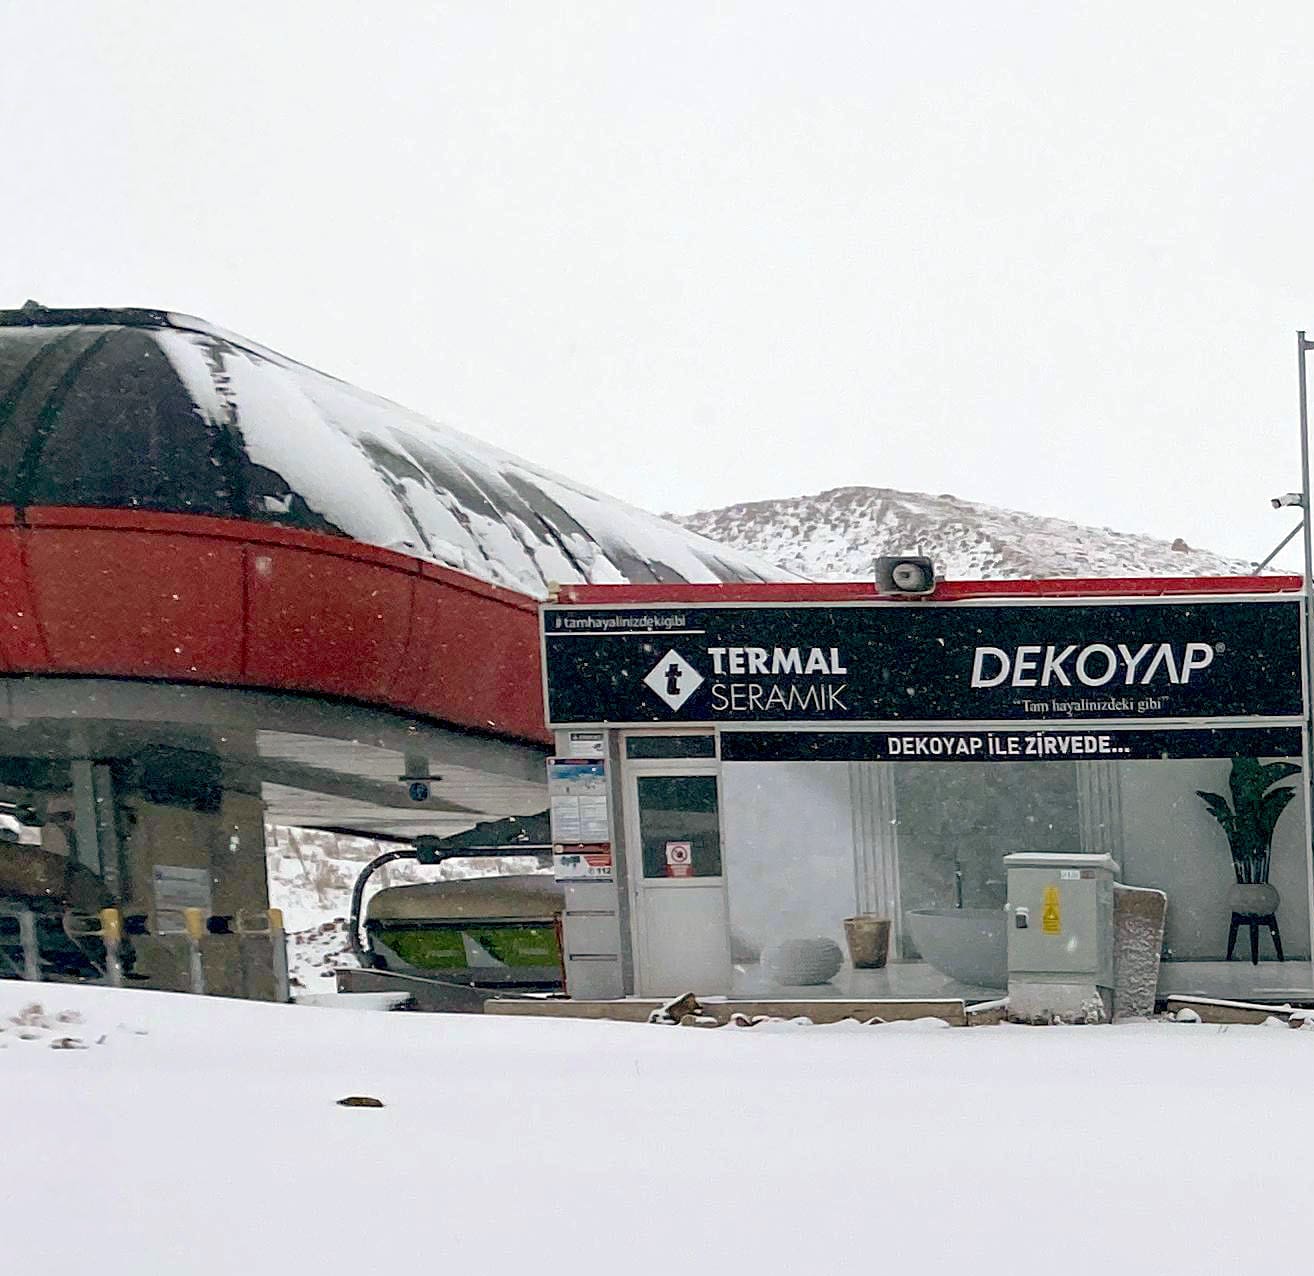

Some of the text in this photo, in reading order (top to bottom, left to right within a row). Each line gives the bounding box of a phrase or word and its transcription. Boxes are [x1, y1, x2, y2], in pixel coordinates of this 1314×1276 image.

[708, 647, 848, 675] TERMAL
[971, 643, 1214, 688] DEKOYAP
[1052, 696, 1134, 717] hayalinizdeki
[888, 737, 982, 755] DEKOYAP
[988, 733, 1020, 754] İLE
